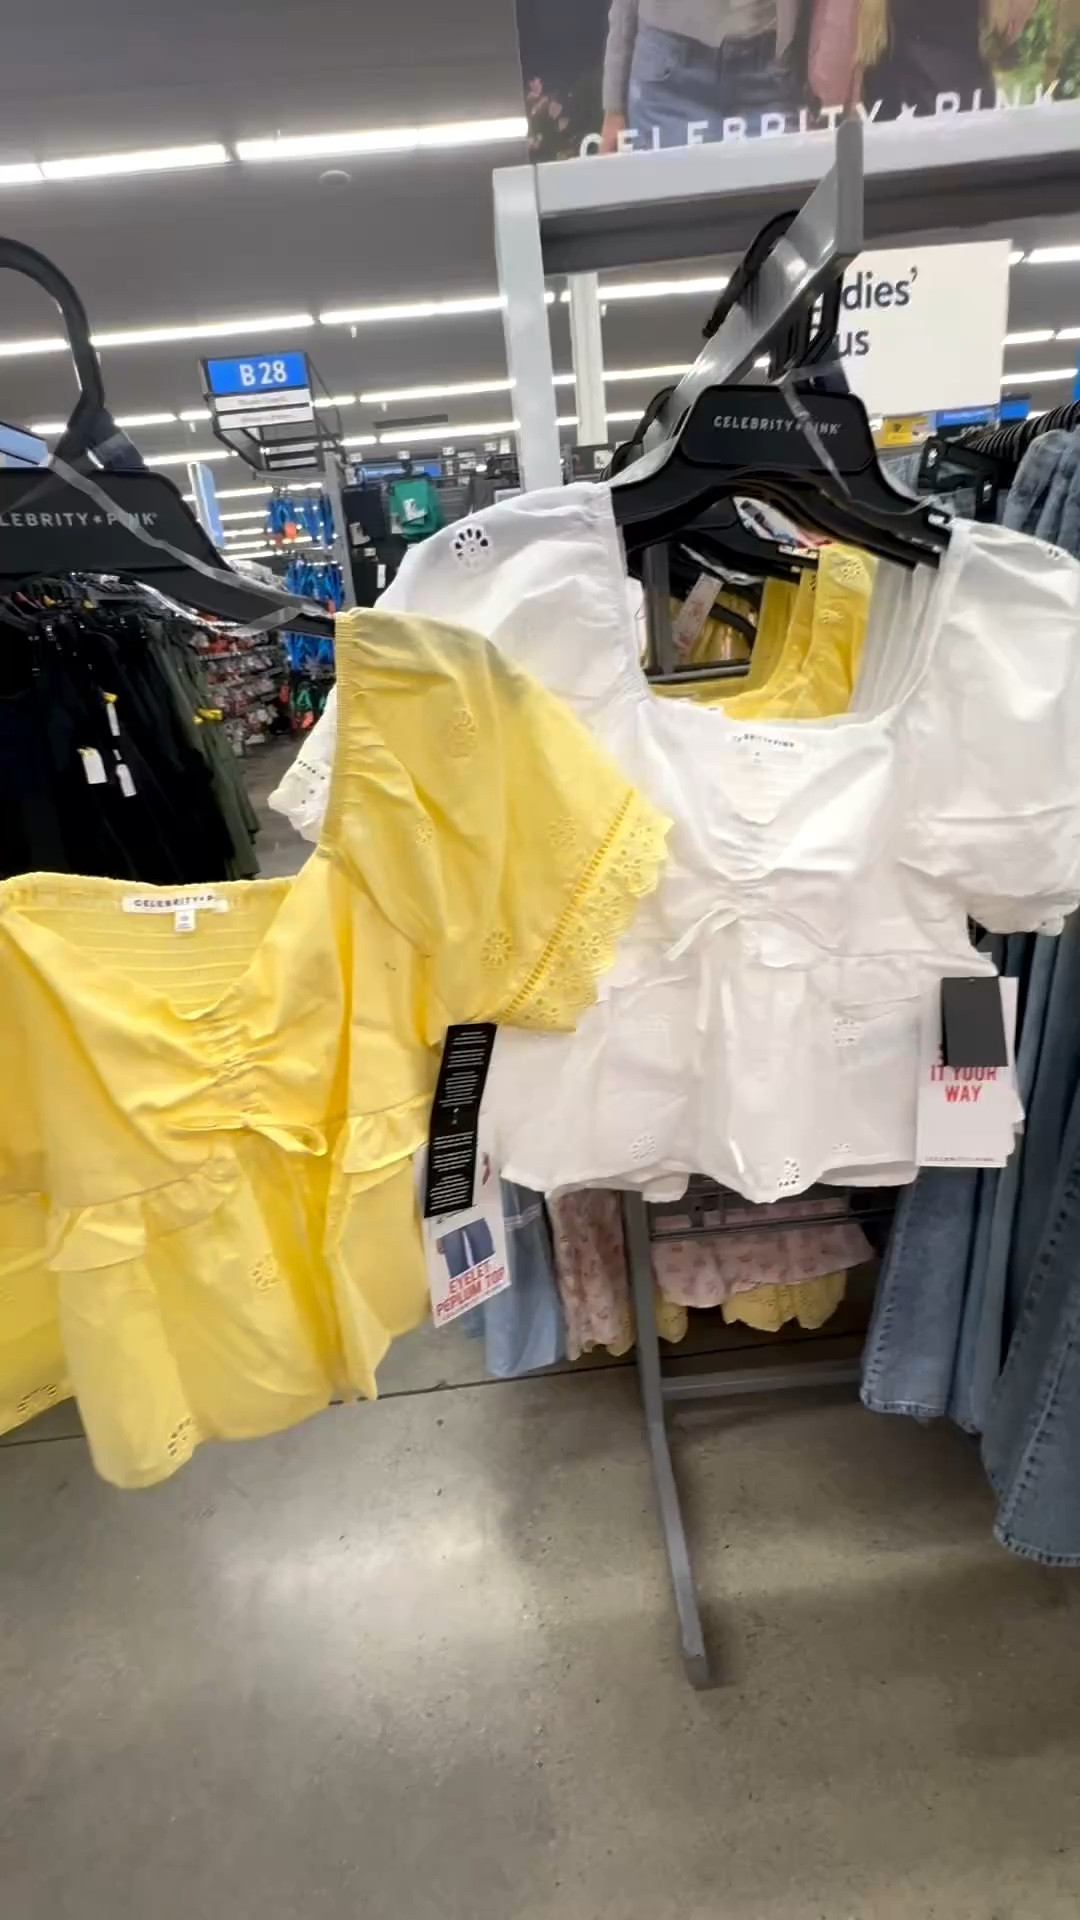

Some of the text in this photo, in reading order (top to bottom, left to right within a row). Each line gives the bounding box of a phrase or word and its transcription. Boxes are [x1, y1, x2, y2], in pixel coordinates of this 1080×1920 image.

[842, 265, 918, 310] dies'
[839, 329, 870, 358] us
[239, 360, 288, 386] B 28
[713, 415, 794, 432] CELEBRITY
[0, 512, 157, 527] LEBRITY PNK
[944, 1085, 982, 1102] WAY
